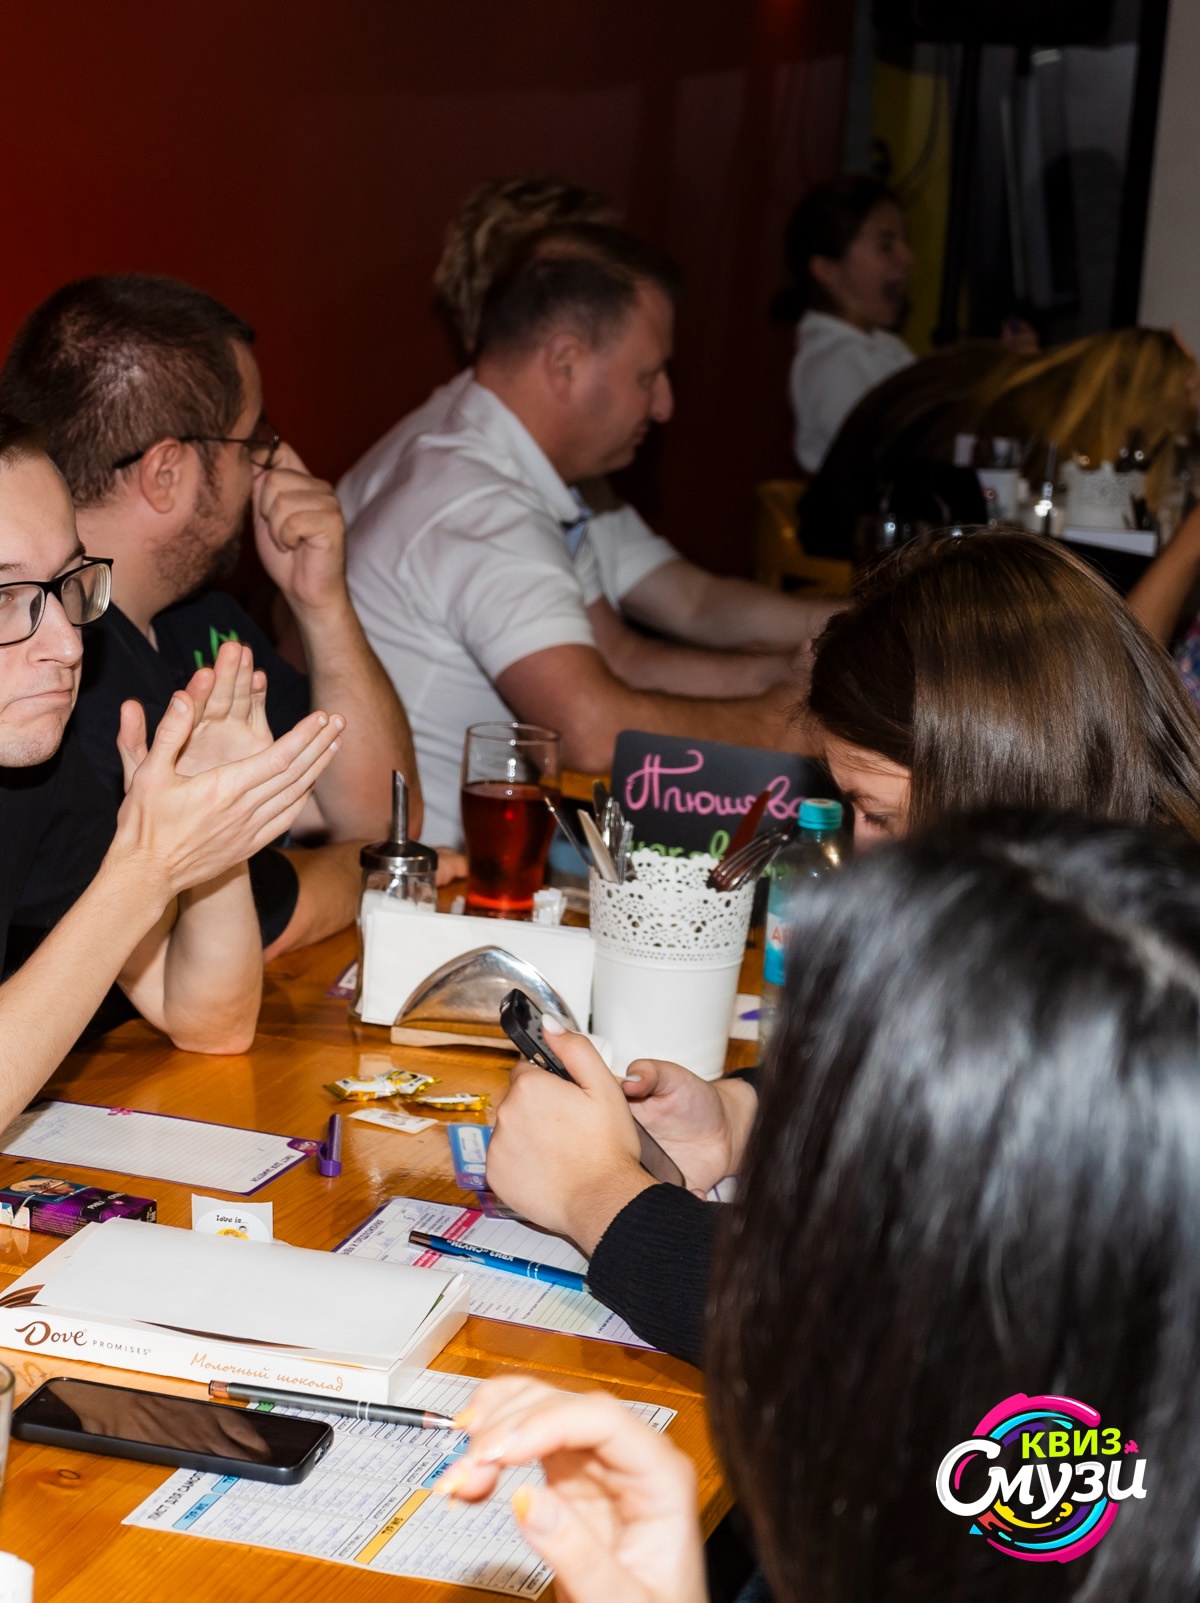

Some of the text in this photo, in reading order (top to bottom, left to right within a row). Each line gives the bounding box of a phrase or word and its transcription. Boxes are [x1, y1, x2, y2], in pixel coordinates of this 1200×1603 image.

[14, 1320, 88, 1346] Dove
[190, 1351, 344, 1392] Молочный шоколад
